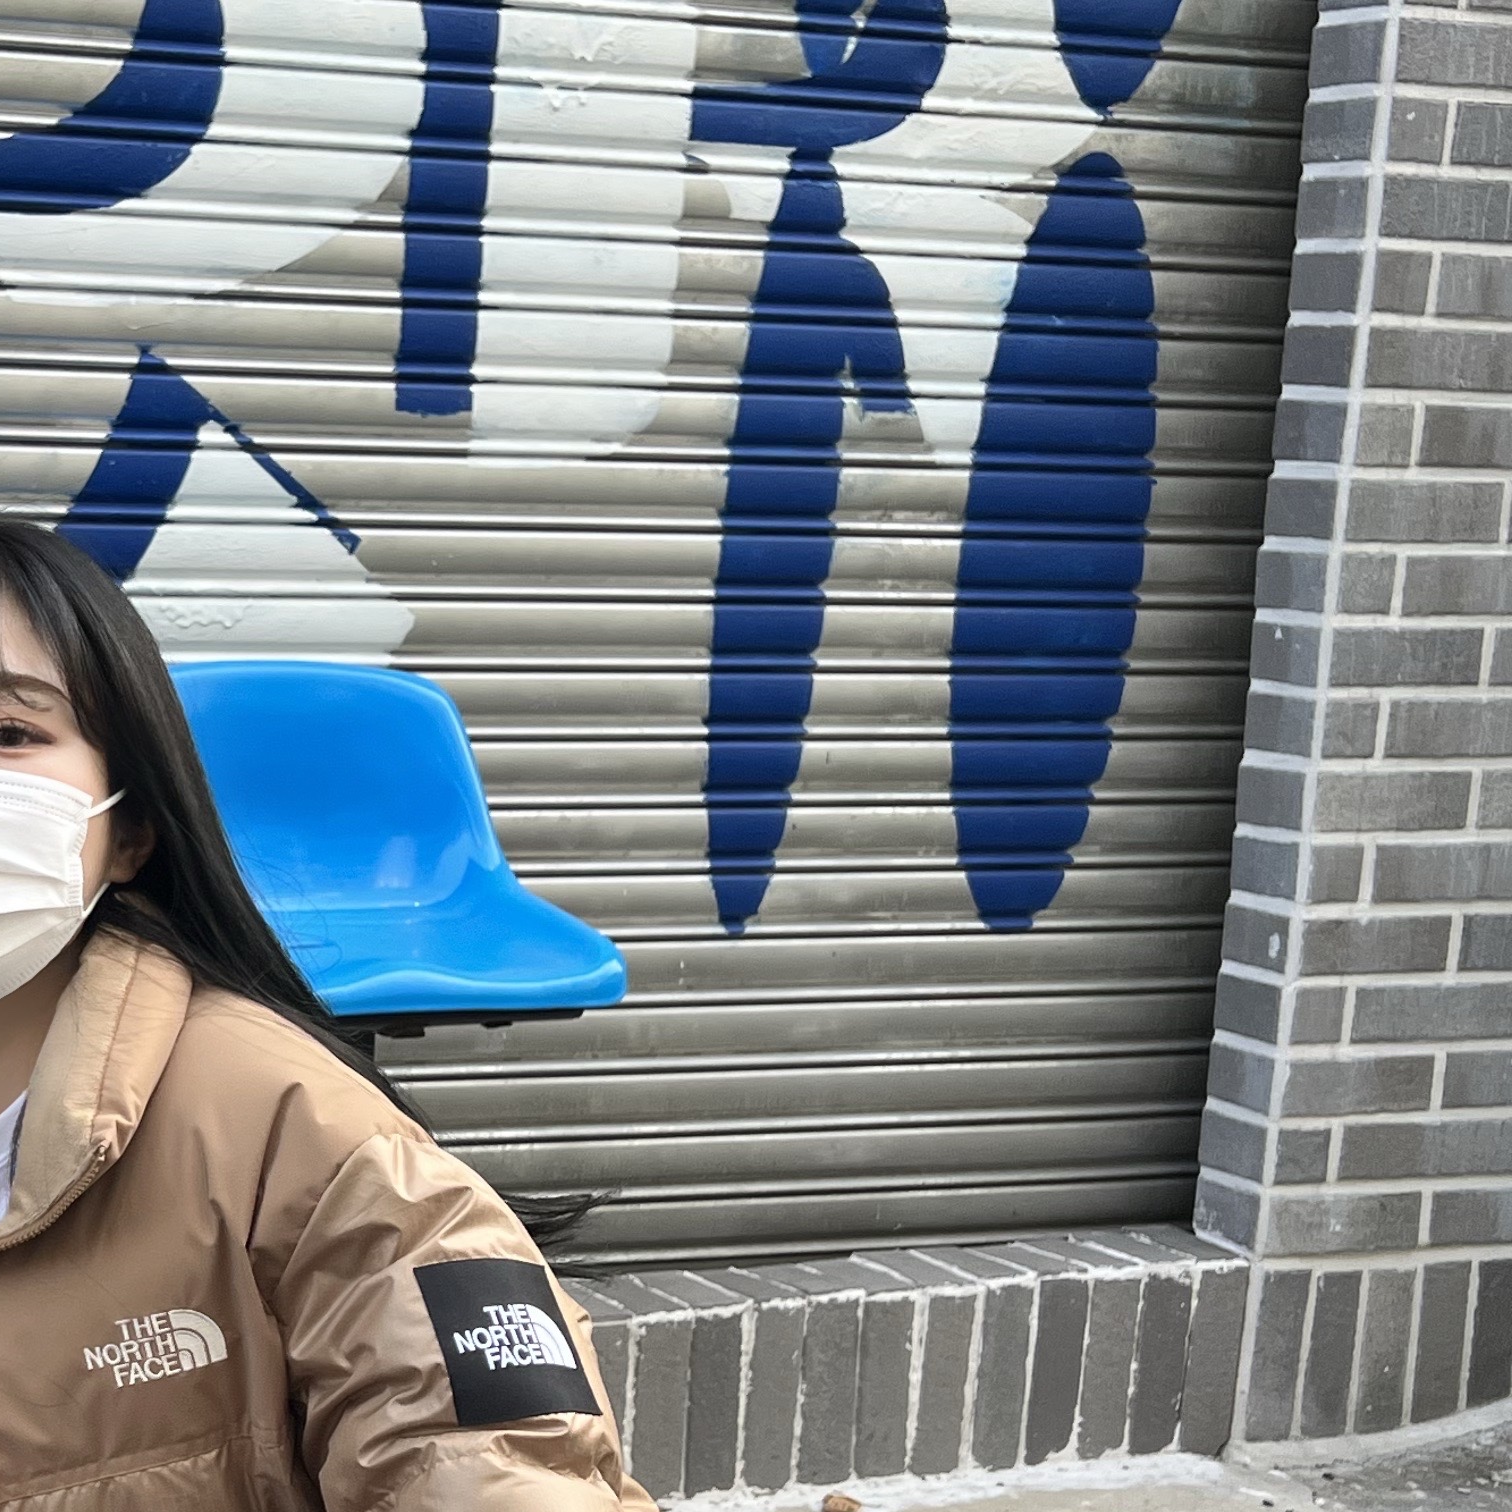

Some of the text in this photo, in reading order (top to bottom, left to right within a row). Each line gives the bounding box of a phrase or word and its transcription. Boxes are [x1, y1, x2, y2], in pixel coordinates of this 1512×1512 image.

[115, 1312, 171, 1341] THE
[483, 1303, 531, 1324] THE
[83, 1332, 176, 1371] NORTH
[453, 1323, 539, 1354] NORTH
[113, 1353, 182, 1388] FACE
[484, 1344, 546, 1371] FACE
